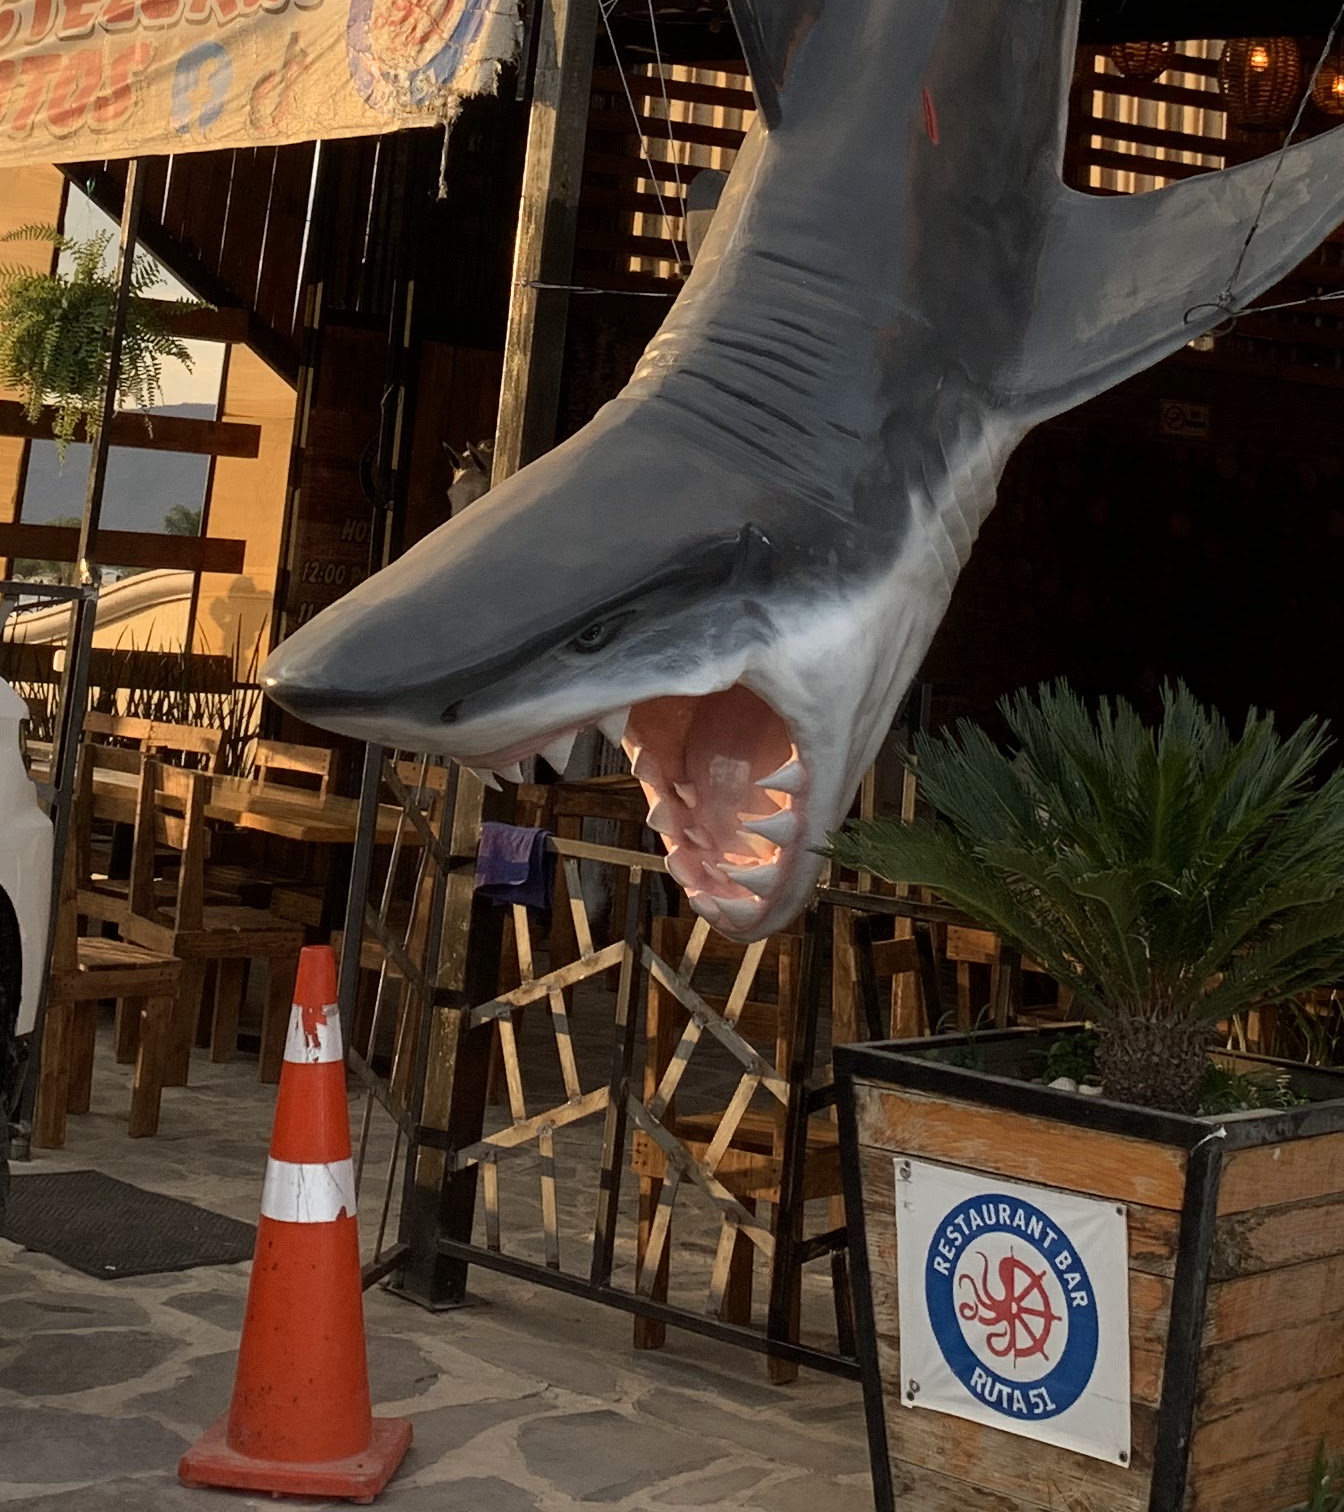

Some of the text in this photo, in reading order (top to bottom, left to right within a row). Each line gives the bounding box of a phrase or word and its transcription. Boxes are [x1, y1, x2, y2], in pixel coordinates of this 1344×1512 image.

[933, 1202, 1089, 1308] RESTAURANT BAR
[969, 1366, 1056, 1415] RUTA 51
